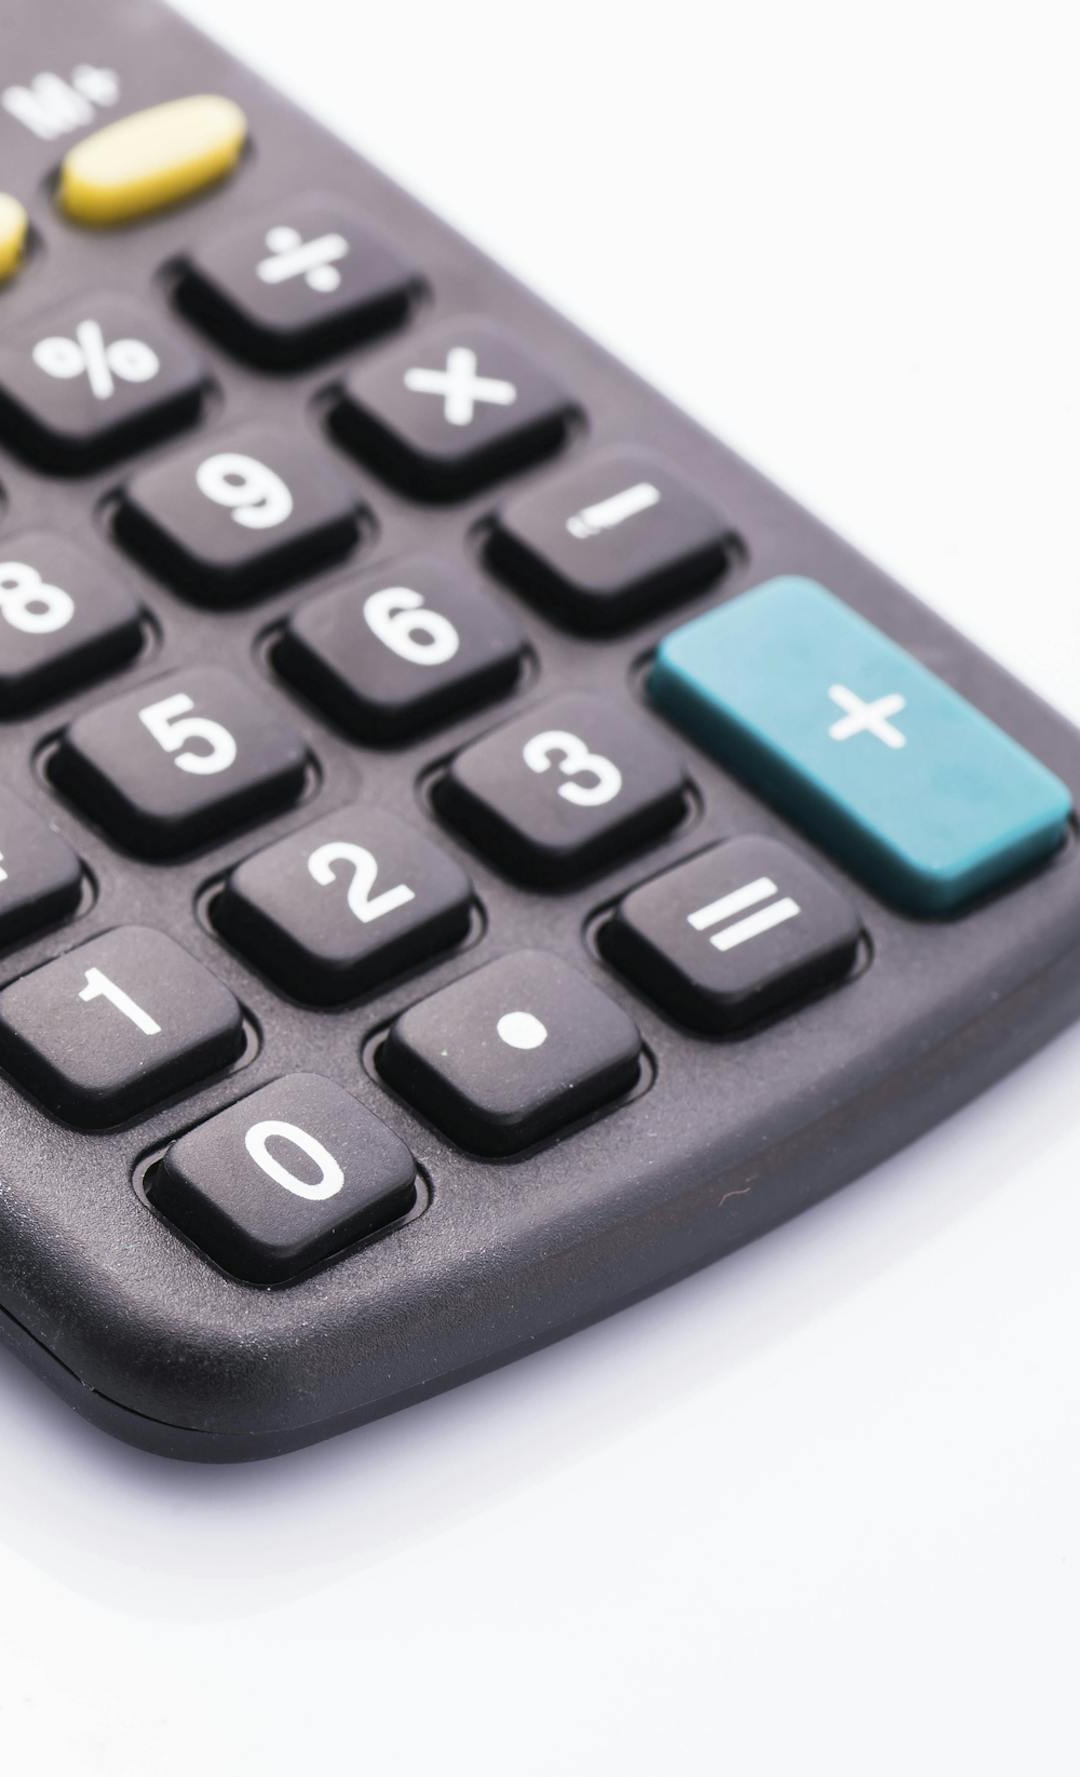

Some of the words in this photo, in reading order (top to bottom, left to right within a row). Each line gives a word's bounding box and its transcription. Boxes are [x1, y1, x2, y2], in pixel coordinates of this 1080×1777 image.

[2, 65, 120, 140] M+
[32, 319, 160, 399] %
[196, 453, 294, 529] 9
[363, 586, 460, 666] 6
[138, 693, 238, 776] 5
[828, 683, 906, 750] +
[522, 730, 623, 807] 3
[307, 841, 416, 924] 2
[78, 966, 163, 1037] 1
[243, 1118, 346, 1202] 0
